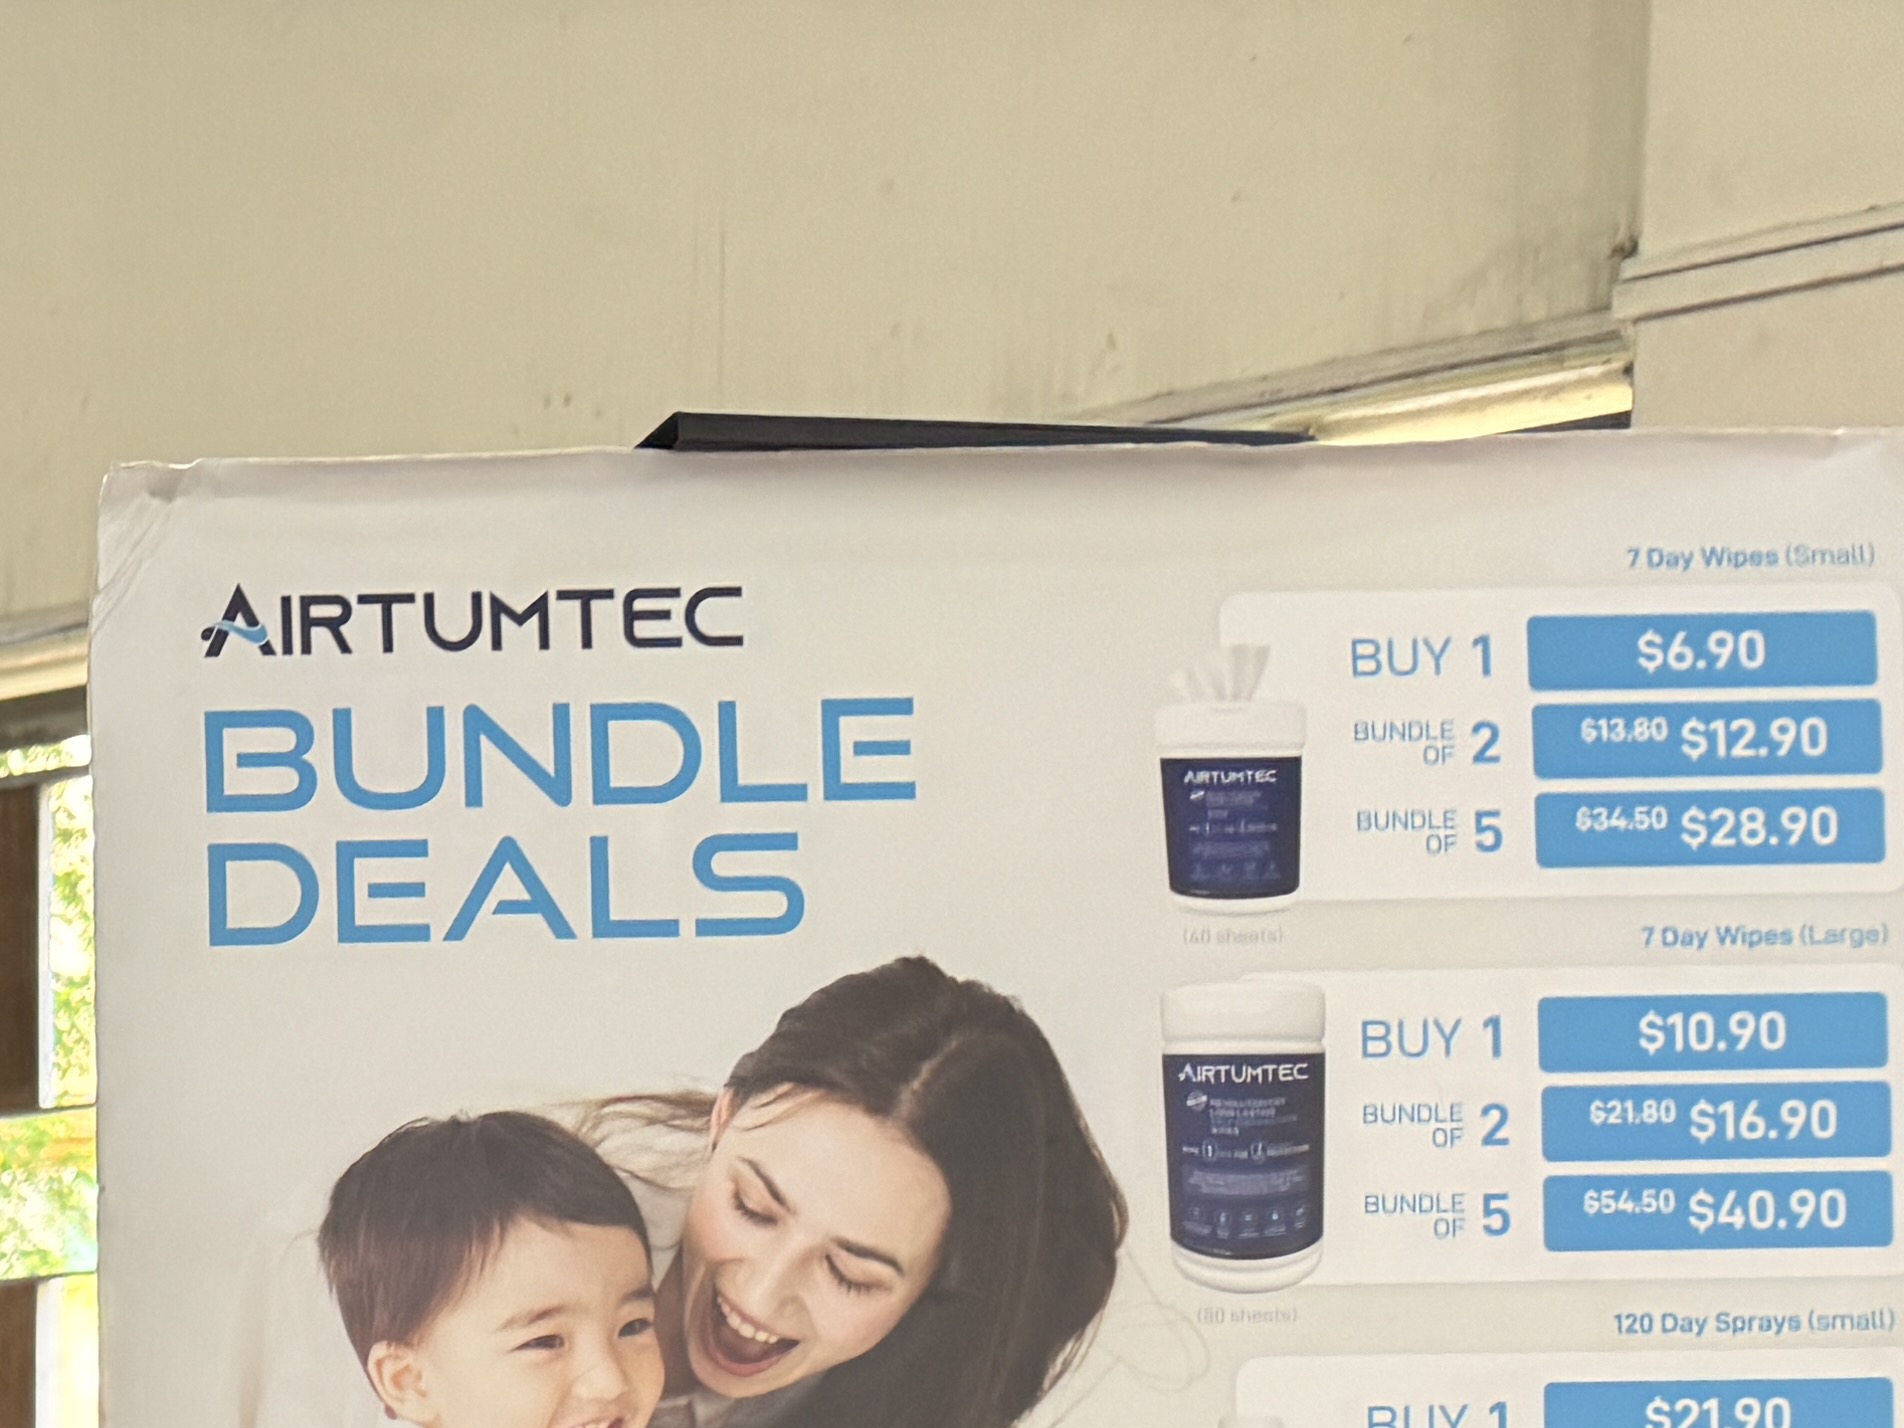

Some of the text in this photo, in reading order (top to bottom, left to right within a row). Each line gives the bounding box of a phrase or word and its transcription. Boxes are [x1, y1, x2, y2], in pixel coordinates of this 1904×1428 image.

[1627, 543, 1877, 572] 7 Day Wipes (Small)
[201, 582, 744, 659] AIRTUMTEC
[1350, 629, 1766, 679] BUY 1 $6.90
[1353, 719, 1455, 744] BUNDLE
[1471, 721, 1501, 765] 2
[1681, 717, 1828, 761] $12.90
[203, 696, 917, 813] BUNDLE
[1423, 744, 1455, 766] OF
[1355, 809, 1457, 833] BUNDLE
[1474, 806, 1838, 854] 5 $34.50 $28.90
[1425, 833, 1457, 855] OF
[206, 830, 805, 947] DEALS
[1641, 921, 1888, 950] 7 Day Wipes (Large)
[1360, 1010, 1786, 1060] BUY 1 $10.90
[1178, 1063, 1309, 1084] AIRTUMTEC
[1363, 1102, 1463, 1126] BUNDLE
[1480, 1098, 1838, 1146] 2 $21.80 $16.90
[1432, 1126, 1464, 1149] OF
[1364, 1193, 1465, 1215] BUNDLE
[1482, 1189, 1847, 1237] 5 $54.50 $40.90
[1433, 1216, 1465, 1239] OF
[1614, 1308, 1895, 1339] 120 Day Sprays (small)
